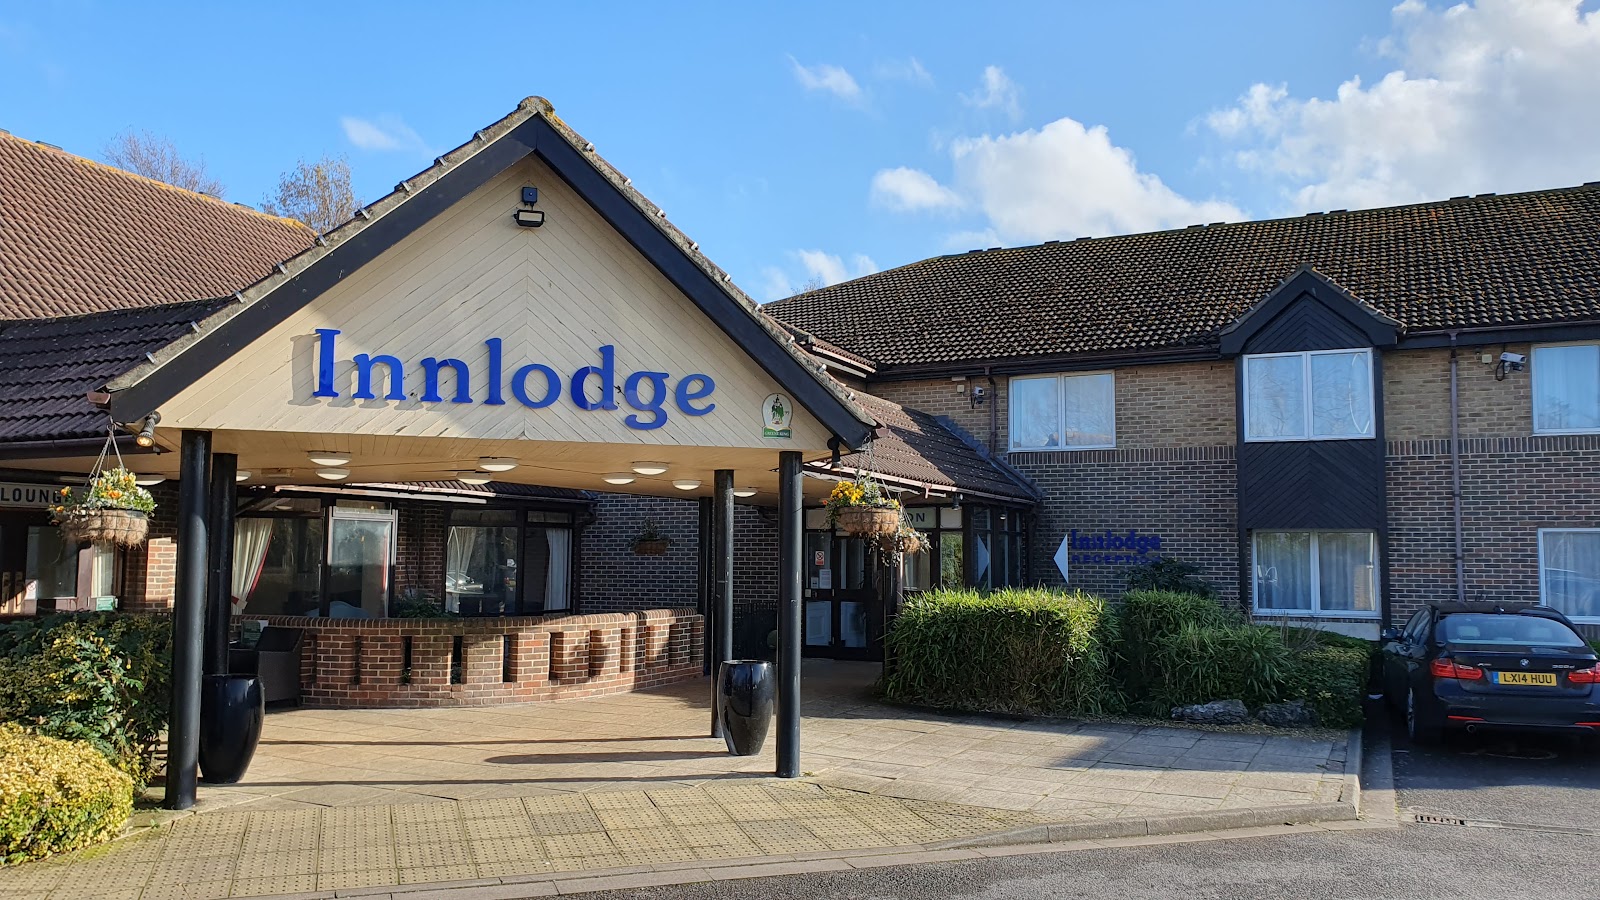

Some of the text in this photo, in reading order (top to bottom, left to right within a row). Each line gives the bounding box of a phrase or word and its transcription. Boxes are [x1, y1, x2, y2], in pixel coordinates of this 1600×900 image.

[312, 328, 716, 430] Innlodge
[1, 487, 72, 503] LOUNG
[1071, 529, 1161, 554] Innlodge
[1503, 673, 1553, 684] LX14 HUU
